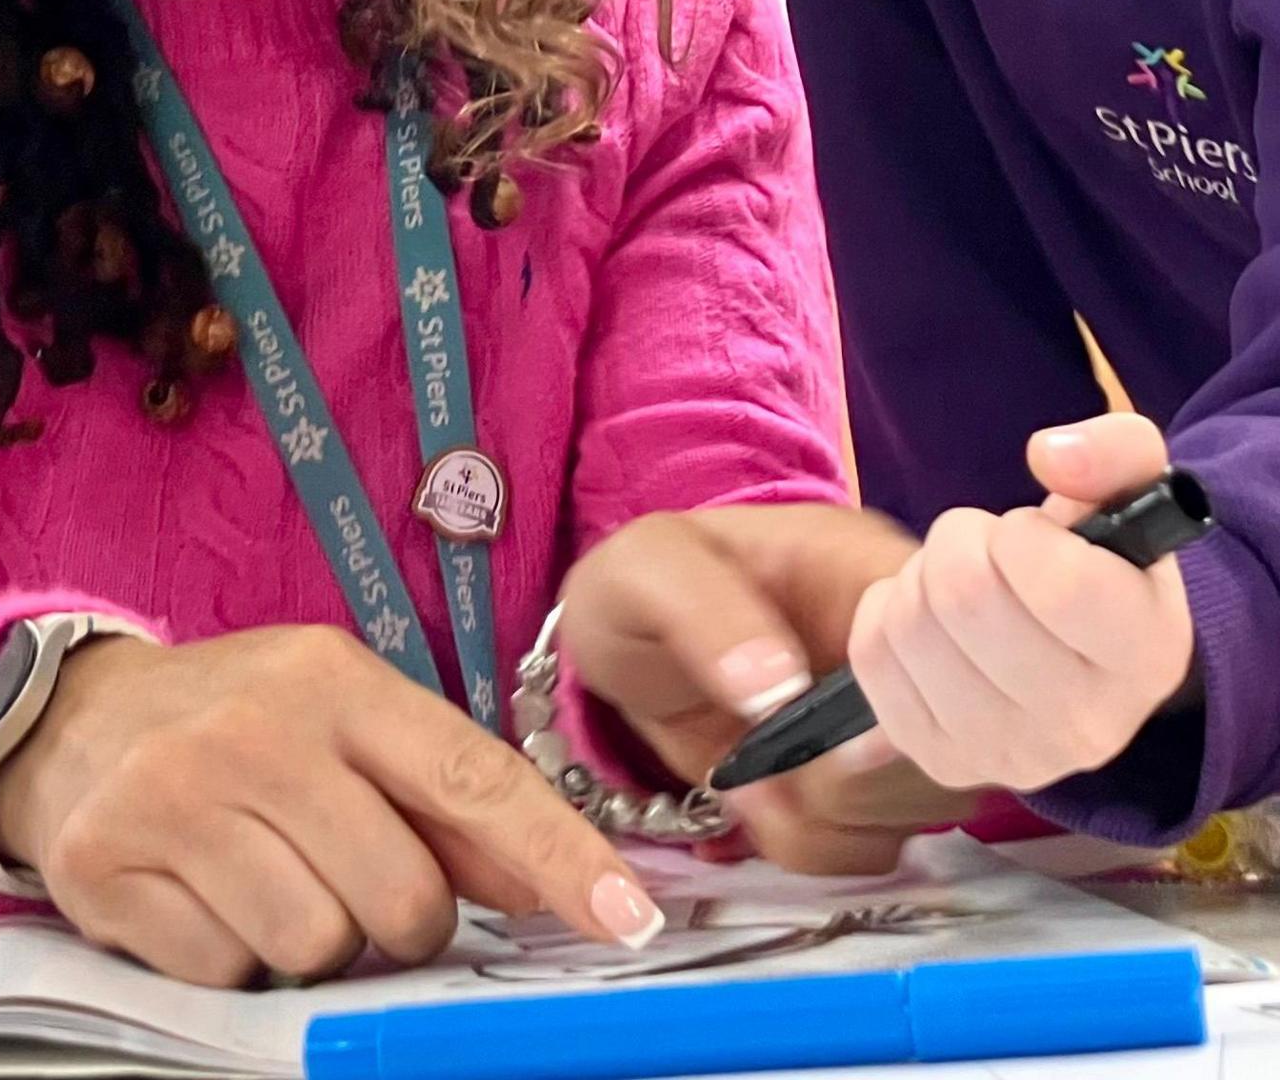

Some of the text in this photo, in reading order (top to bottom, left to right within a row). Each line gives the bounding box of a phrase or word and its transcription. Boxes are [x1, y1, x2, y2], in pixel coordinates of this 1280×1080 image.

[1095, 106, 1258, 184] St Piers
[1147, 155, 1240, 204] School
[247, 310, 292, 385] Piers
[421, 351, 452, 428] Piers
[329, 494, 375, 573] Piers
[451, 555, 477, 633] Piers
